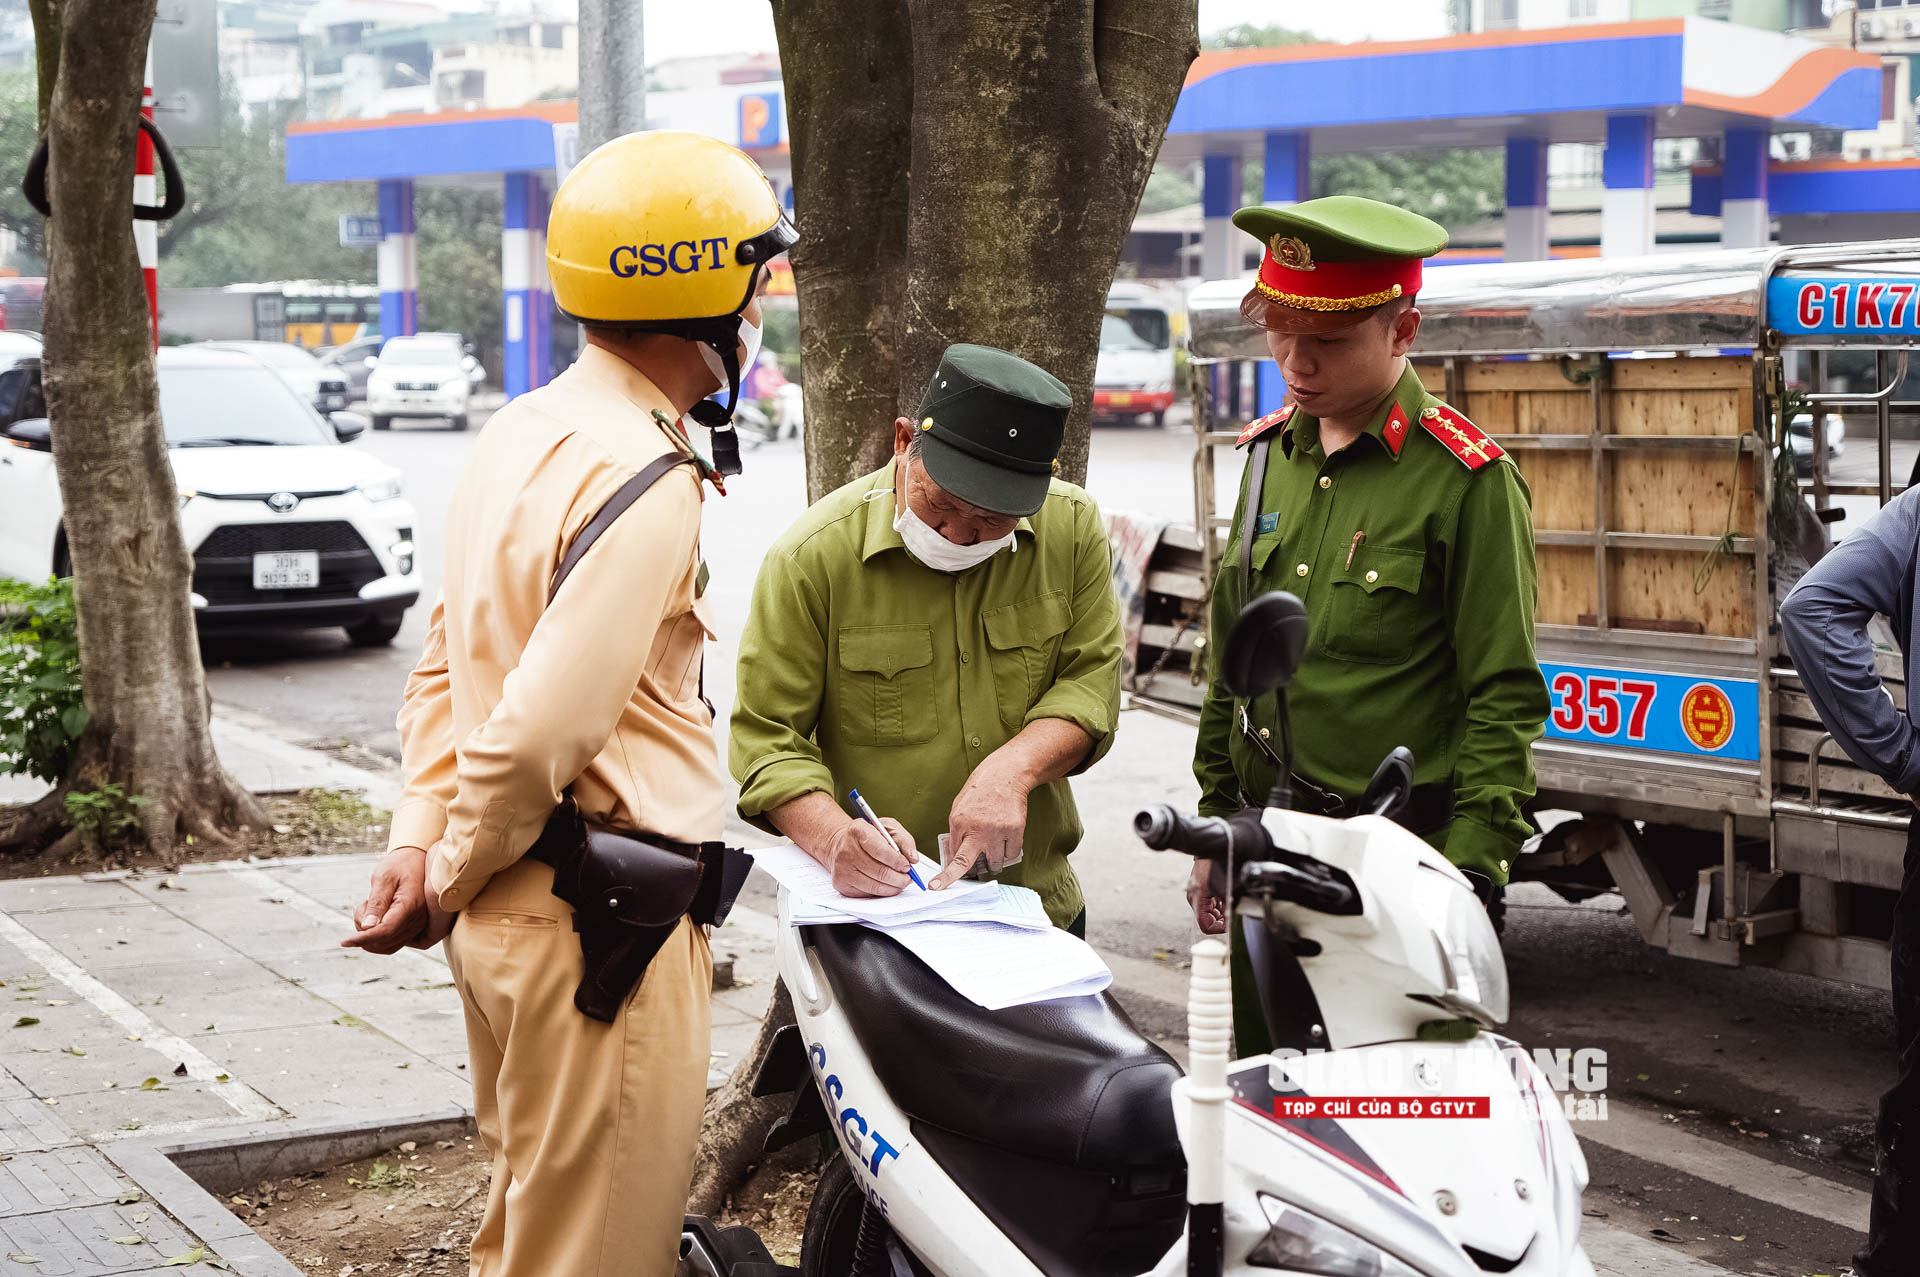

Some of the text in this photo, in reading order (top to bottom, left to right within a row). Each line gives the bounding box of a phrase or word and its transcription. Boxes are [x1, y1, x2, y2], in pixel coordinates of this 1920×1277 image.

[609, 237, 728, 278] CSGT
[1797, 282, 1920, 329] C1K7
[1552, 672, 1657, 740] 357
